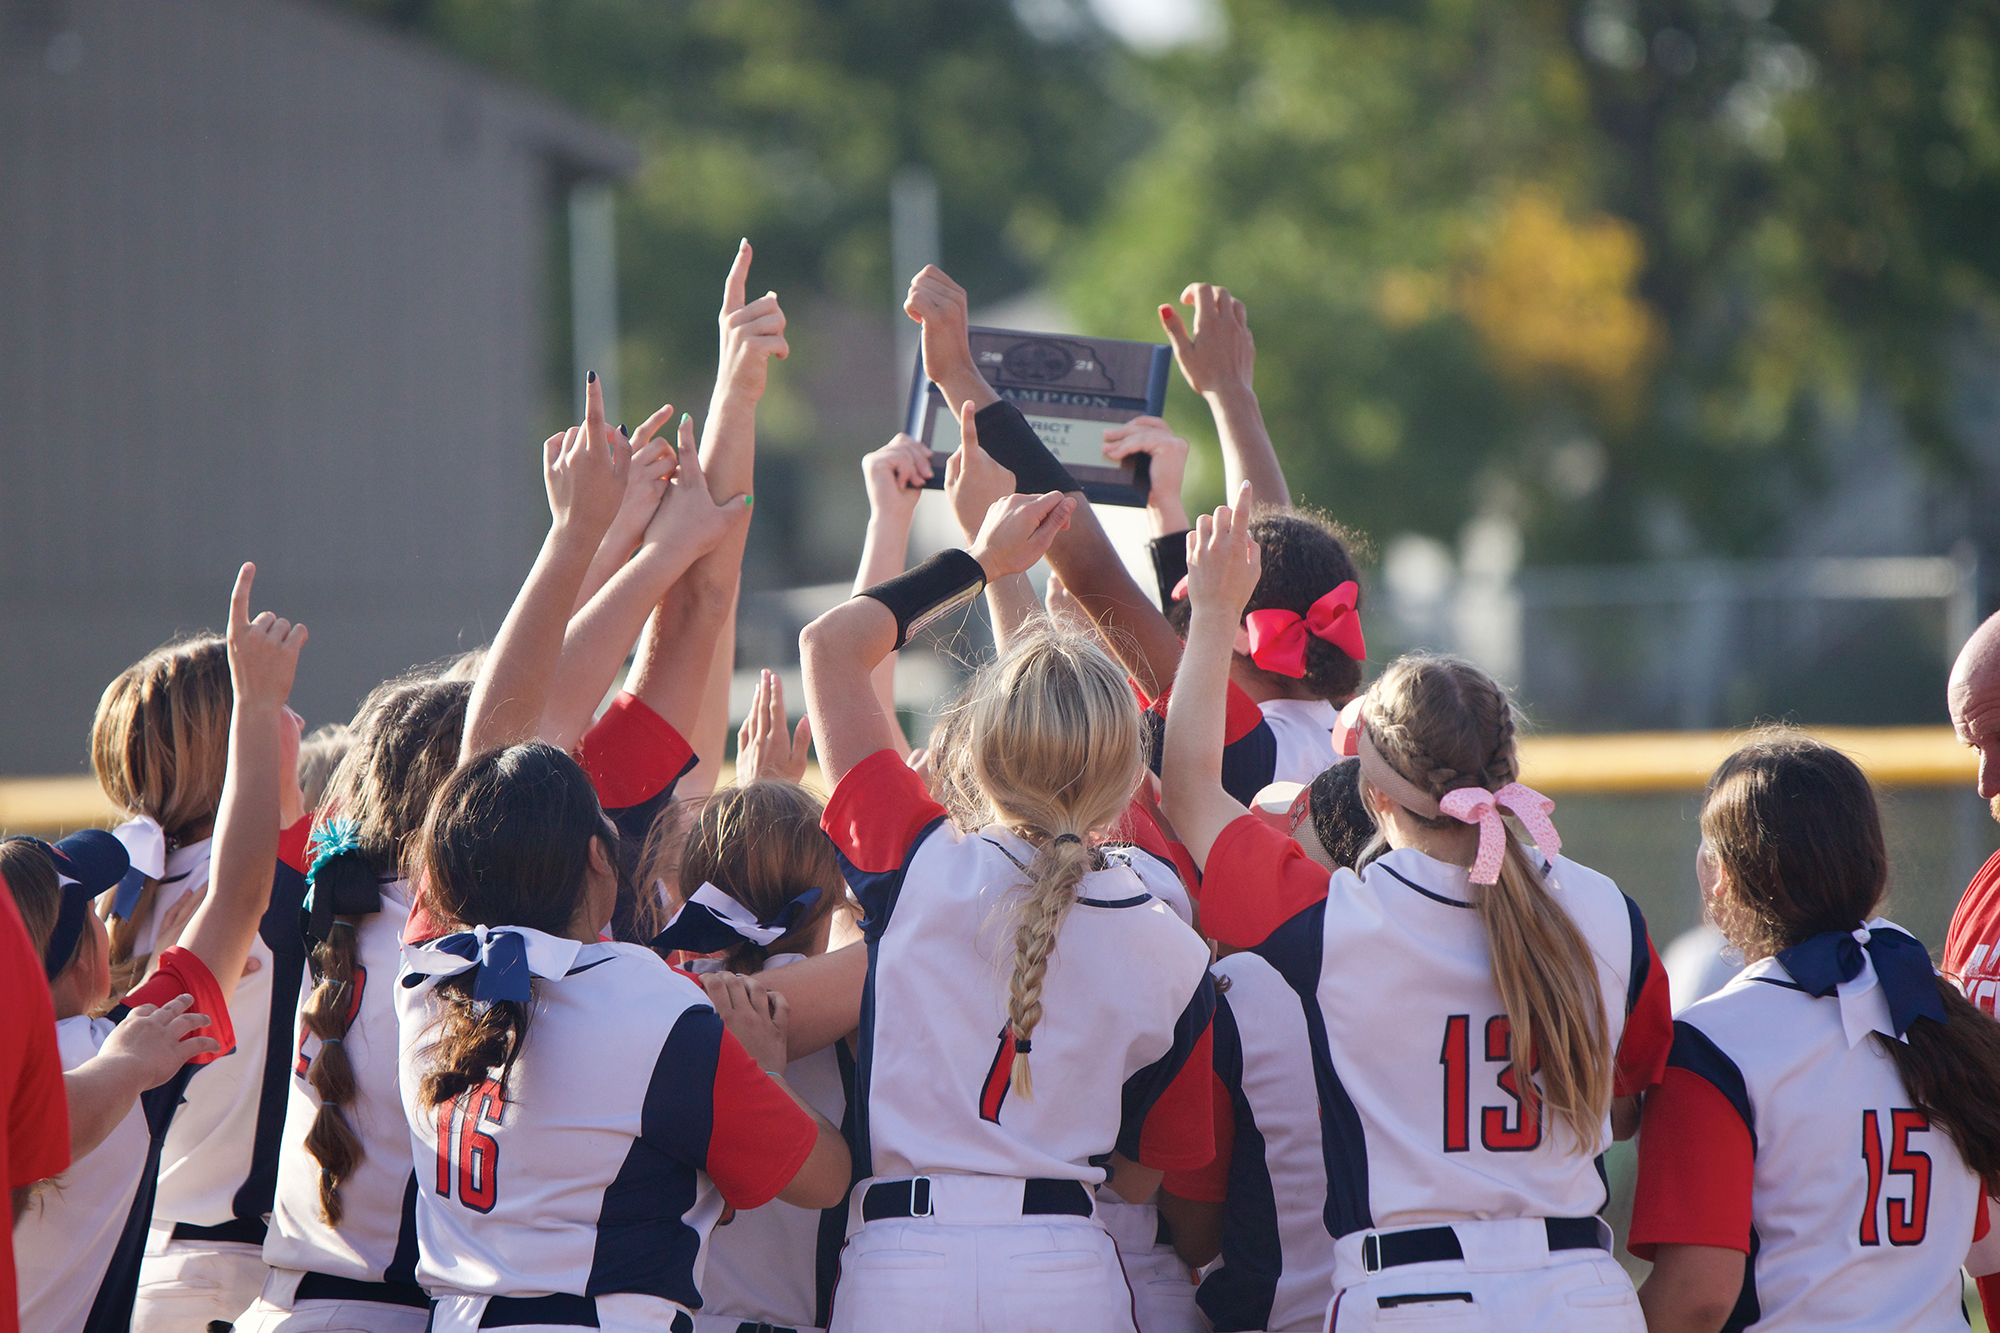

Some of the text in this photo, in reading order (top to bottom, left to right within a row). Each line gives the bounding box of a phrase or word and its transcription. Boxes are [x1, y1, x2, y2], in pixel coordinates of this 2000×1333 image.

[980, 351, 1094, 372] 20 21
[997, 387, 1110, 408] AMPION
[1030, 421, 1073, 433] RICT
[1042, 435, 1069, 446] ALL
[1439, 1014, 1542, 1153] 13
[435, 1076, 507, 1214] 16
[1859, 1108, 1932, 1247] 15
